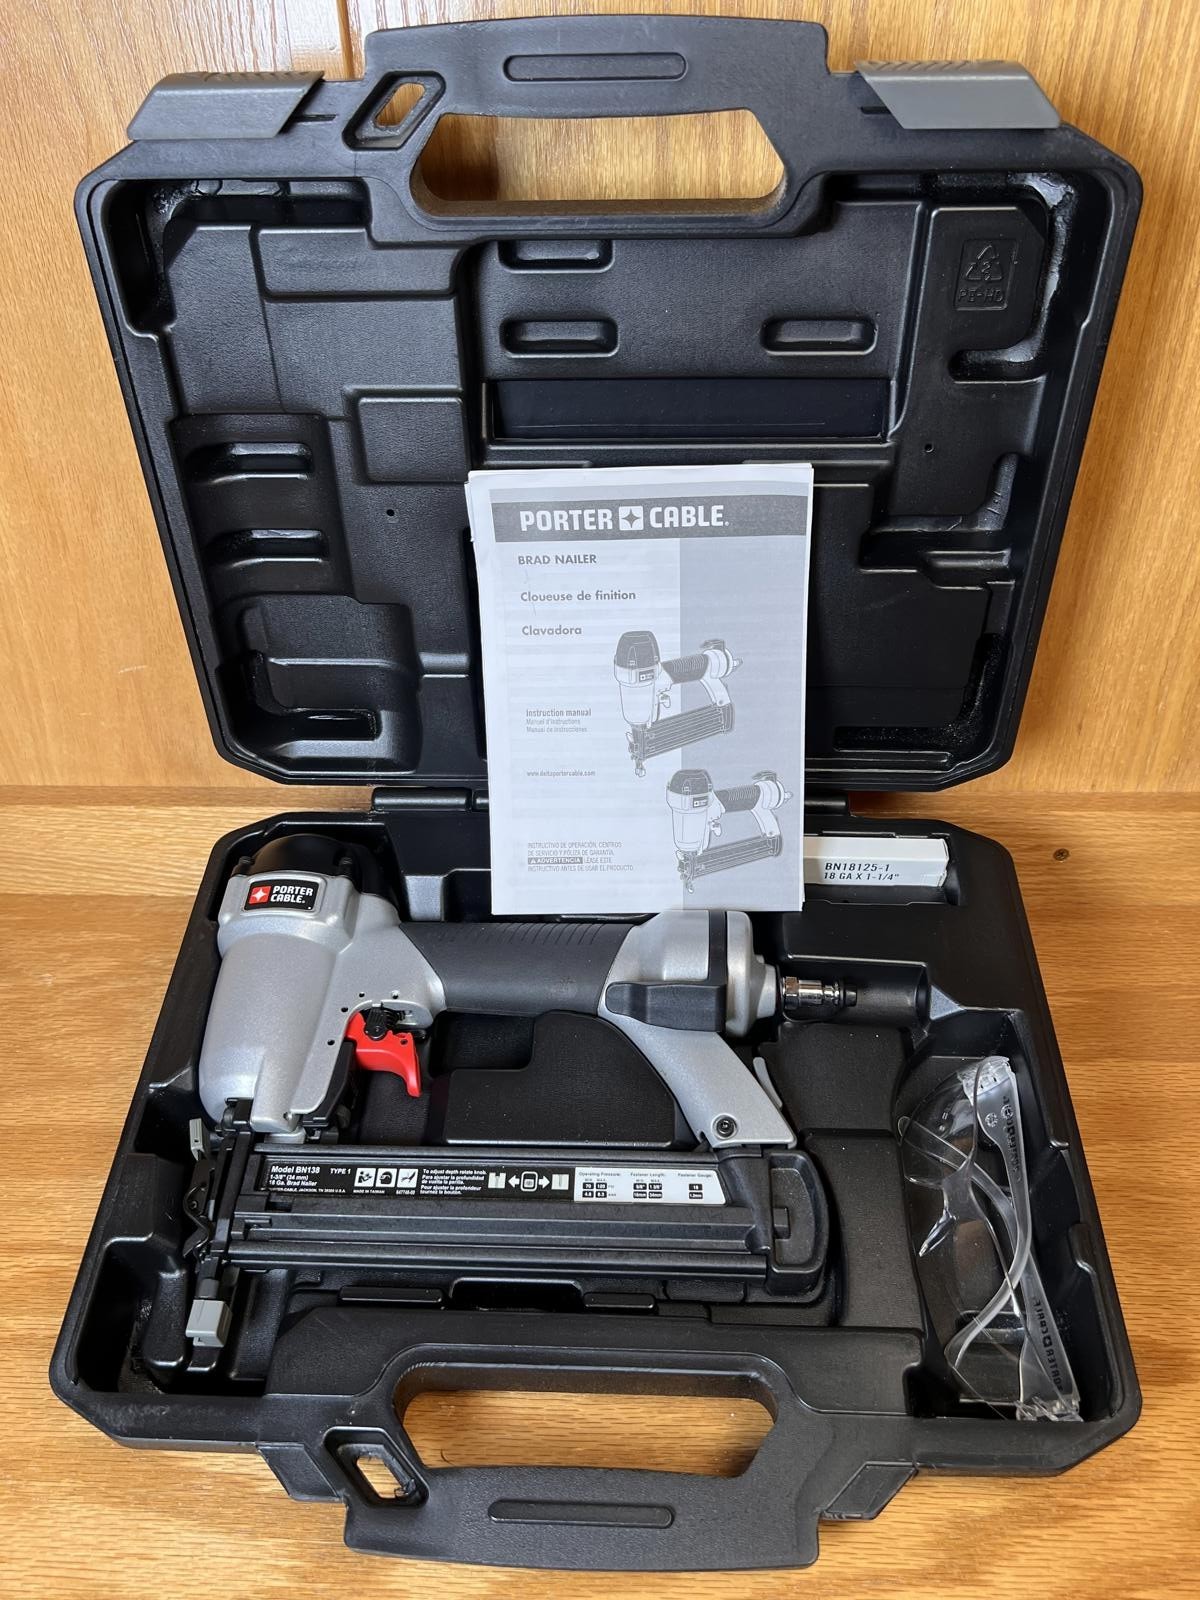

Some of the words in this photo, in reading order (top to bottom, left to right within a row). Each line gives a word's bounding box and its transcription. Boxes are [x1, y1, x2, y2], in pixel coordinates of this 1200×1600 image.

[519, 509, 613, 531] PORTER
[518, 555, 550, 565] BRAD
[555, 554, 597, 564] NAILER
[520, 591, 573, 602] Cloueuse
[577, 590, 592, 601] de
[595, 589, 636, 600] finition
[521, 625, 583, 636] Clavadora
[526, 708, 564, 717] Instruction
[565, 708, 592, 717] manual
[825, 862, 890, 872] BN18125-1
[824, 872, 836, 880] 18
[867, 873, 899, 881] 1-1/4"
[272, 886, 314, 896] PORTER
[296, 1166, 320, 1174] BN138
